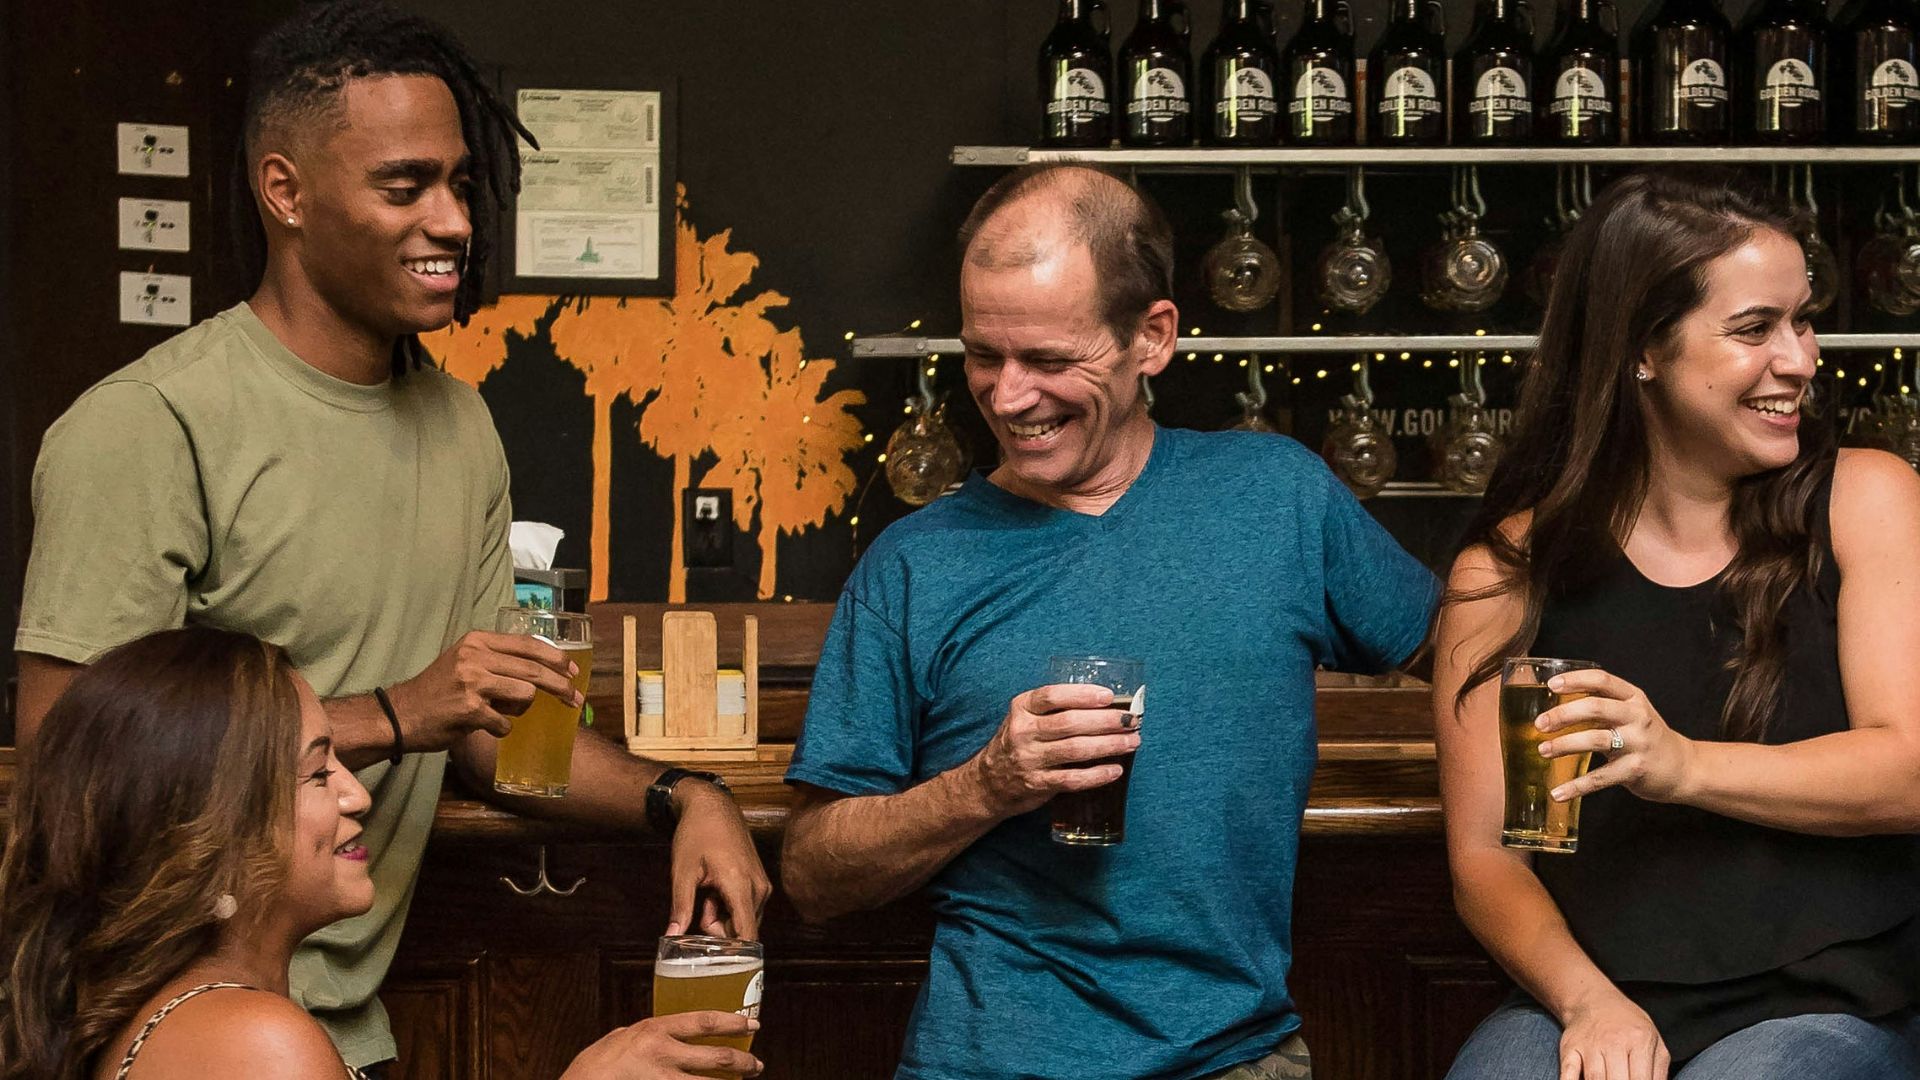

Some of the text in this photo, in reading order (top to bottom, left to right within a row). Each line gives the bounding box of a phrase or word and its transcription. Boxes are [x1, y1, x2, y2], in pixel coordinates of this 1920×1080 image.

[1216, 99, 1256, 113] GODEN
[1289, 99, 1327, 113] GOLEN
[1550, 99, 1585, 114] GOLDN
